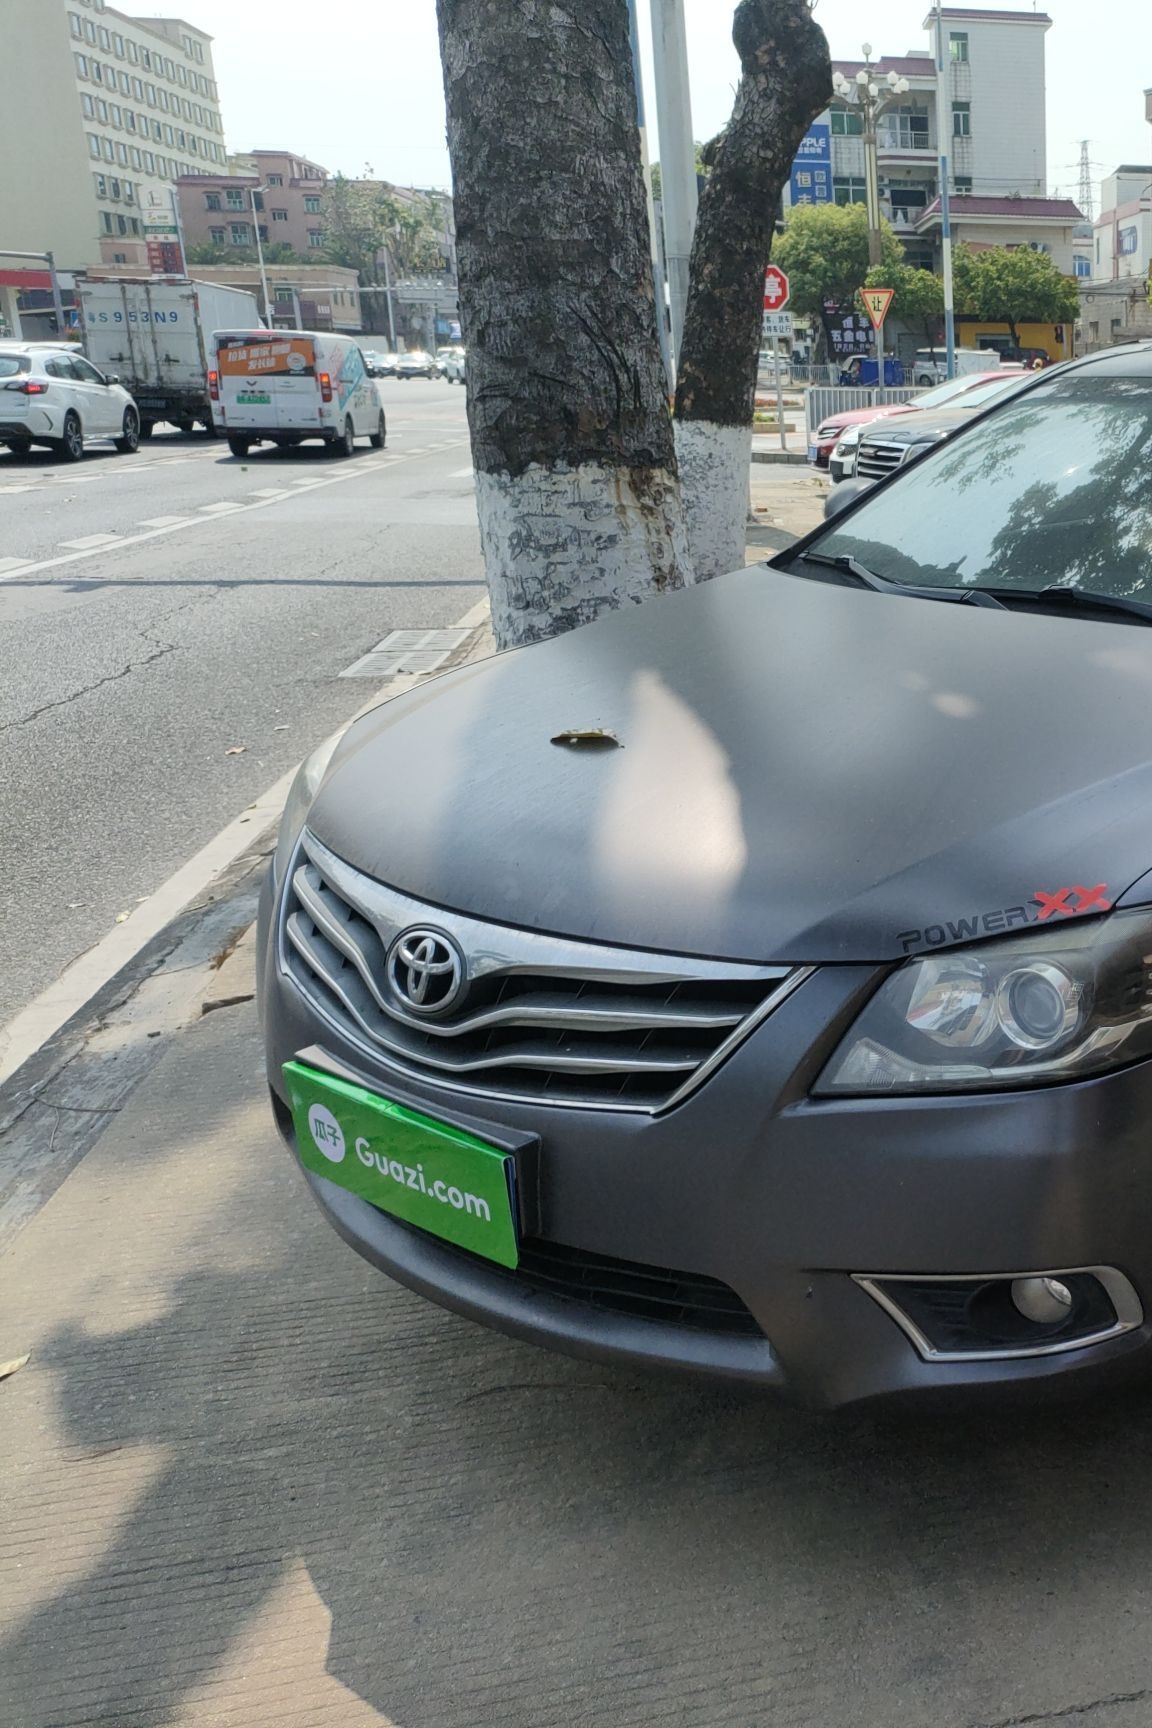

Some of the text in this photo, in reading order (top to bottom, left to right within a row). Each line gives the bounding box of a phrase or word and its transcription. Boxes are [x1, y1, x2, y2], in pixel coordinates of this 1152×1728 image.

[871, 296, 882, 312] 让
[314, 1117, 341, 1147] 瓜子
[355, 1136, 492, 1223] Guazi.com
